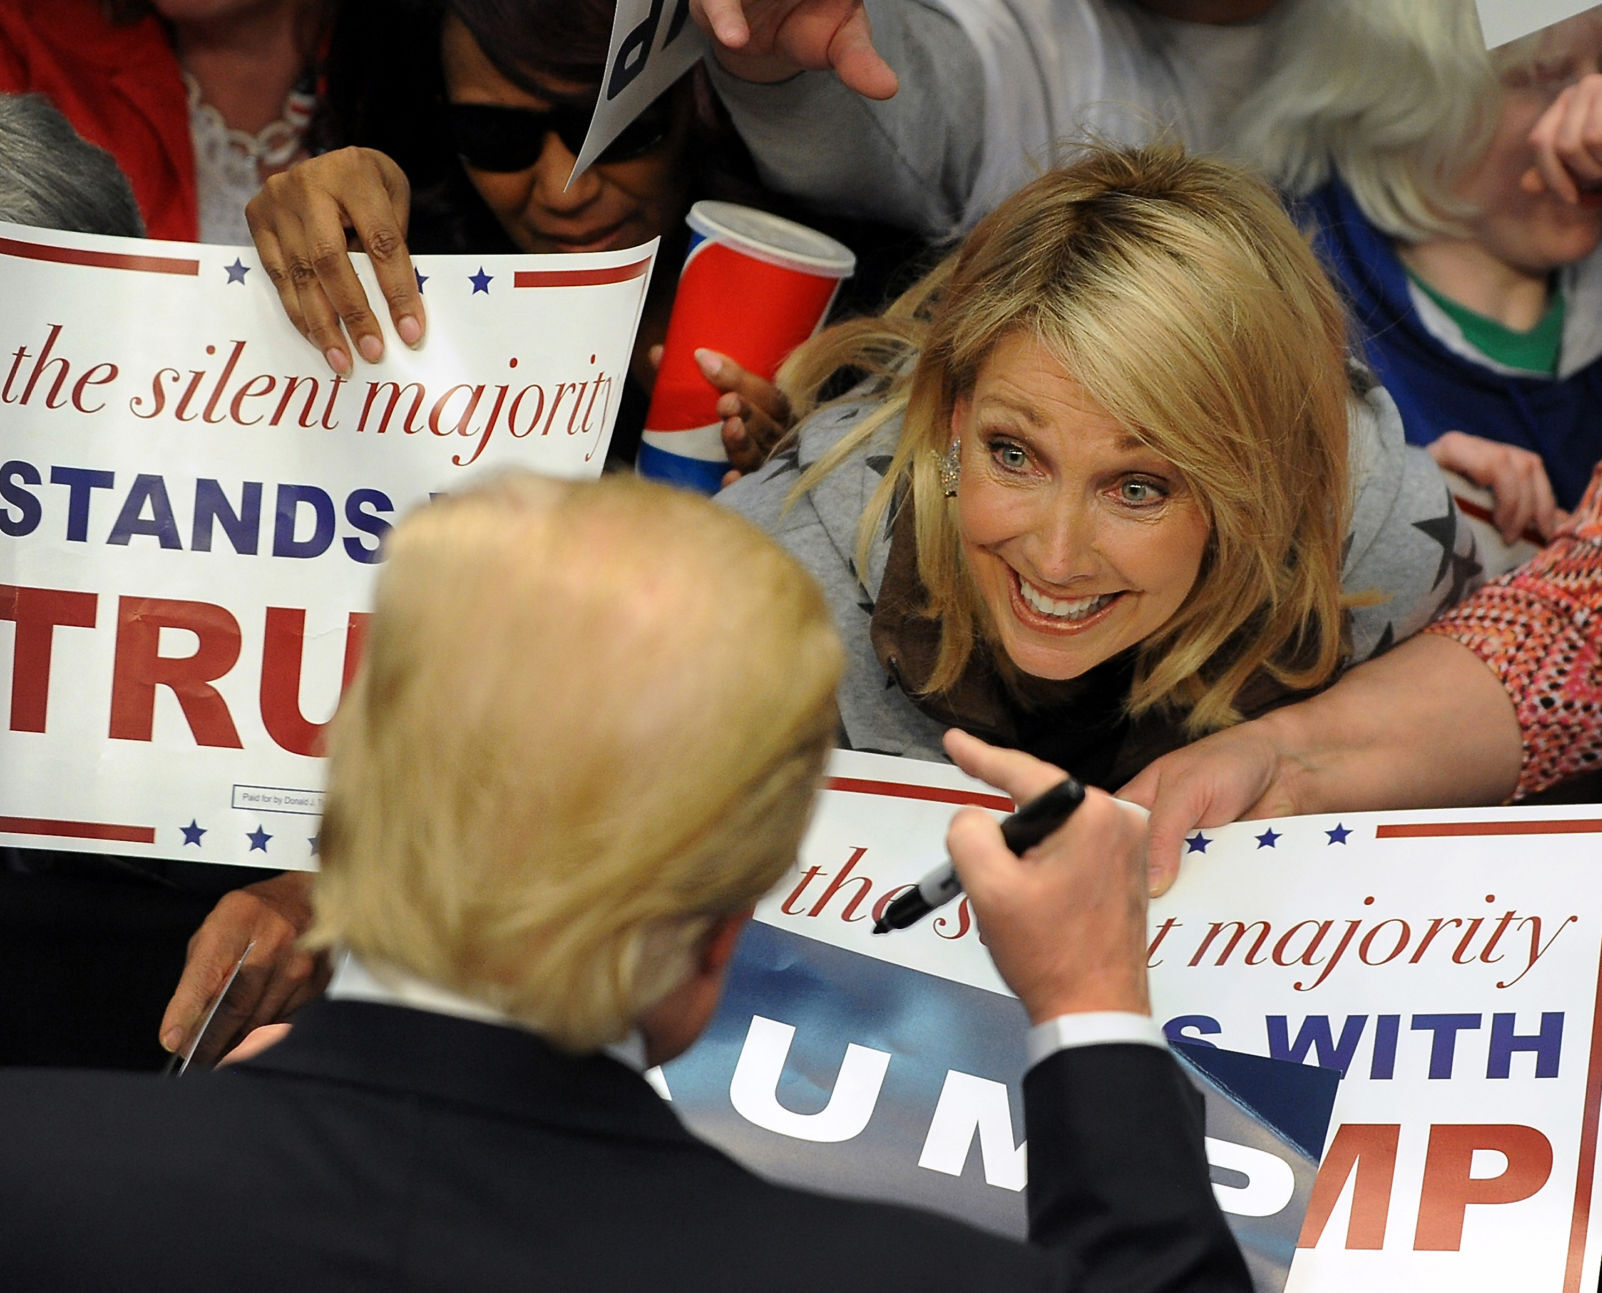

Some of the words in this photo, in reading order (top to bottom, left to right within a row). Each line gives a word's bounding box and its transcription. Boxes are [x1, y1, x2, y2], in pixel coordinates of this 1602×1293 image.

[1, 324, 119, 414] the
[130, 339, 348, 430] silent
[356, 353, 612, 467] majority
[0, 460, 395, 564] STANDS
[0, 584, 375, 758] TRU
[242, 792, 260, 802] Paid
[262, 795, 272, 803] for
[273, 796, 282, 805] by
[1188, 894, 1579, 991] majority
[1265, 1011, 1566, 1080] WITH
